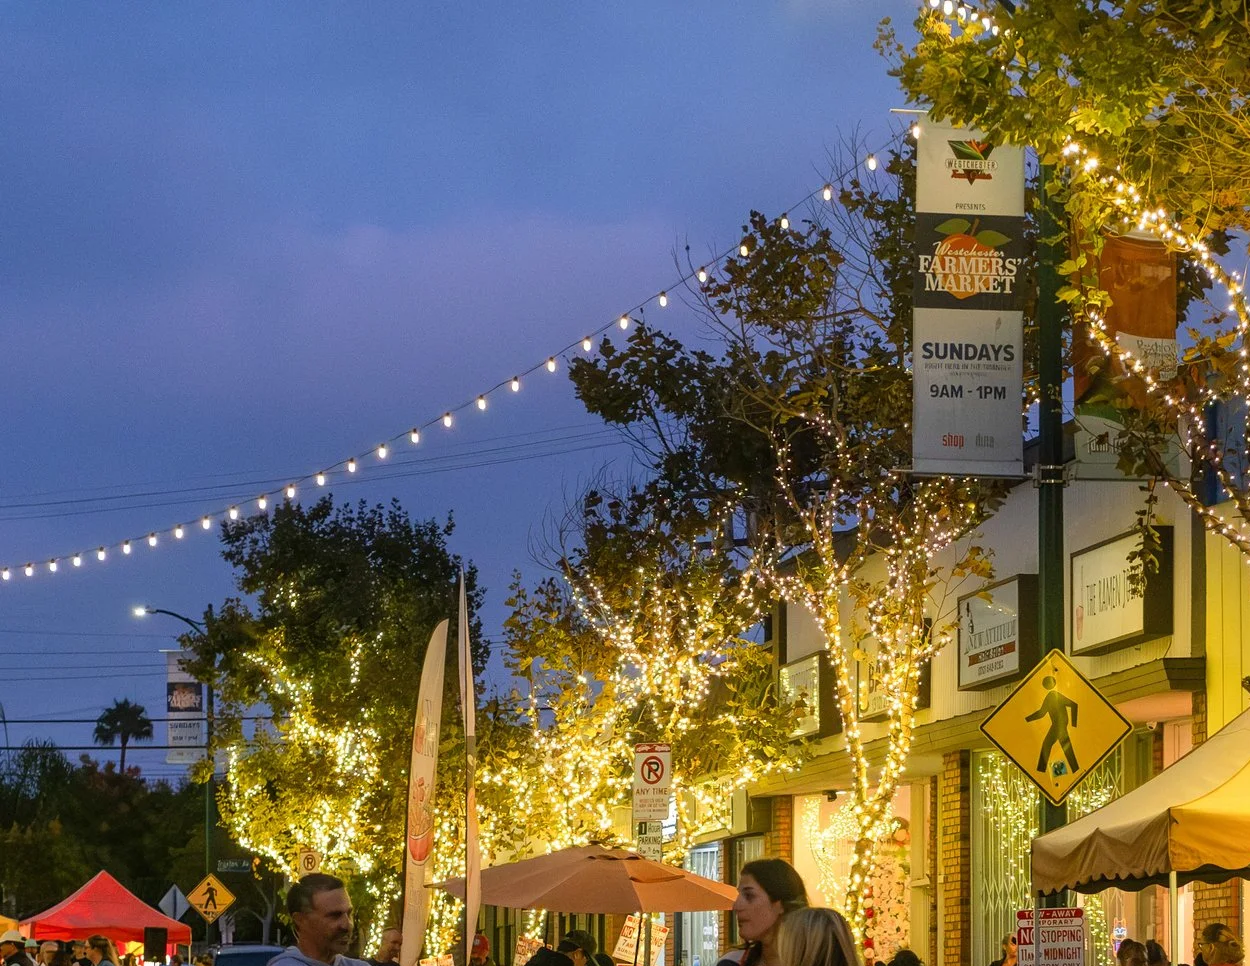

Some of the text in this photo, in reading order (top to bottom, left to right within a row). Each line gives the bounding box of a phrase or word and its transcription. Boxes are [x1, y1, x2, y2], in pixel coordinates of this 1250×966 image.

[948, 160, 995, 169] WESTCHESTER
[933, 241, 1005, 257] Westchester
[924, 273, 1016, 294] MARKET
[922, 342, 1015, 361] SUNDAYS
[930, 384, 963, 399] 9AM
[976, 385, 1006, 400] 1PM
[942, 433, 965, 449] shop
[636, 787, 668, 796] ANY TIME
[639, 837, 661, 845] PARKING
[1052, 910, 1076, 918] AWAY
[1041, 930, 1082, 943] STOPPING
[1044, 947, 1081, 960] MIDNIGHT
